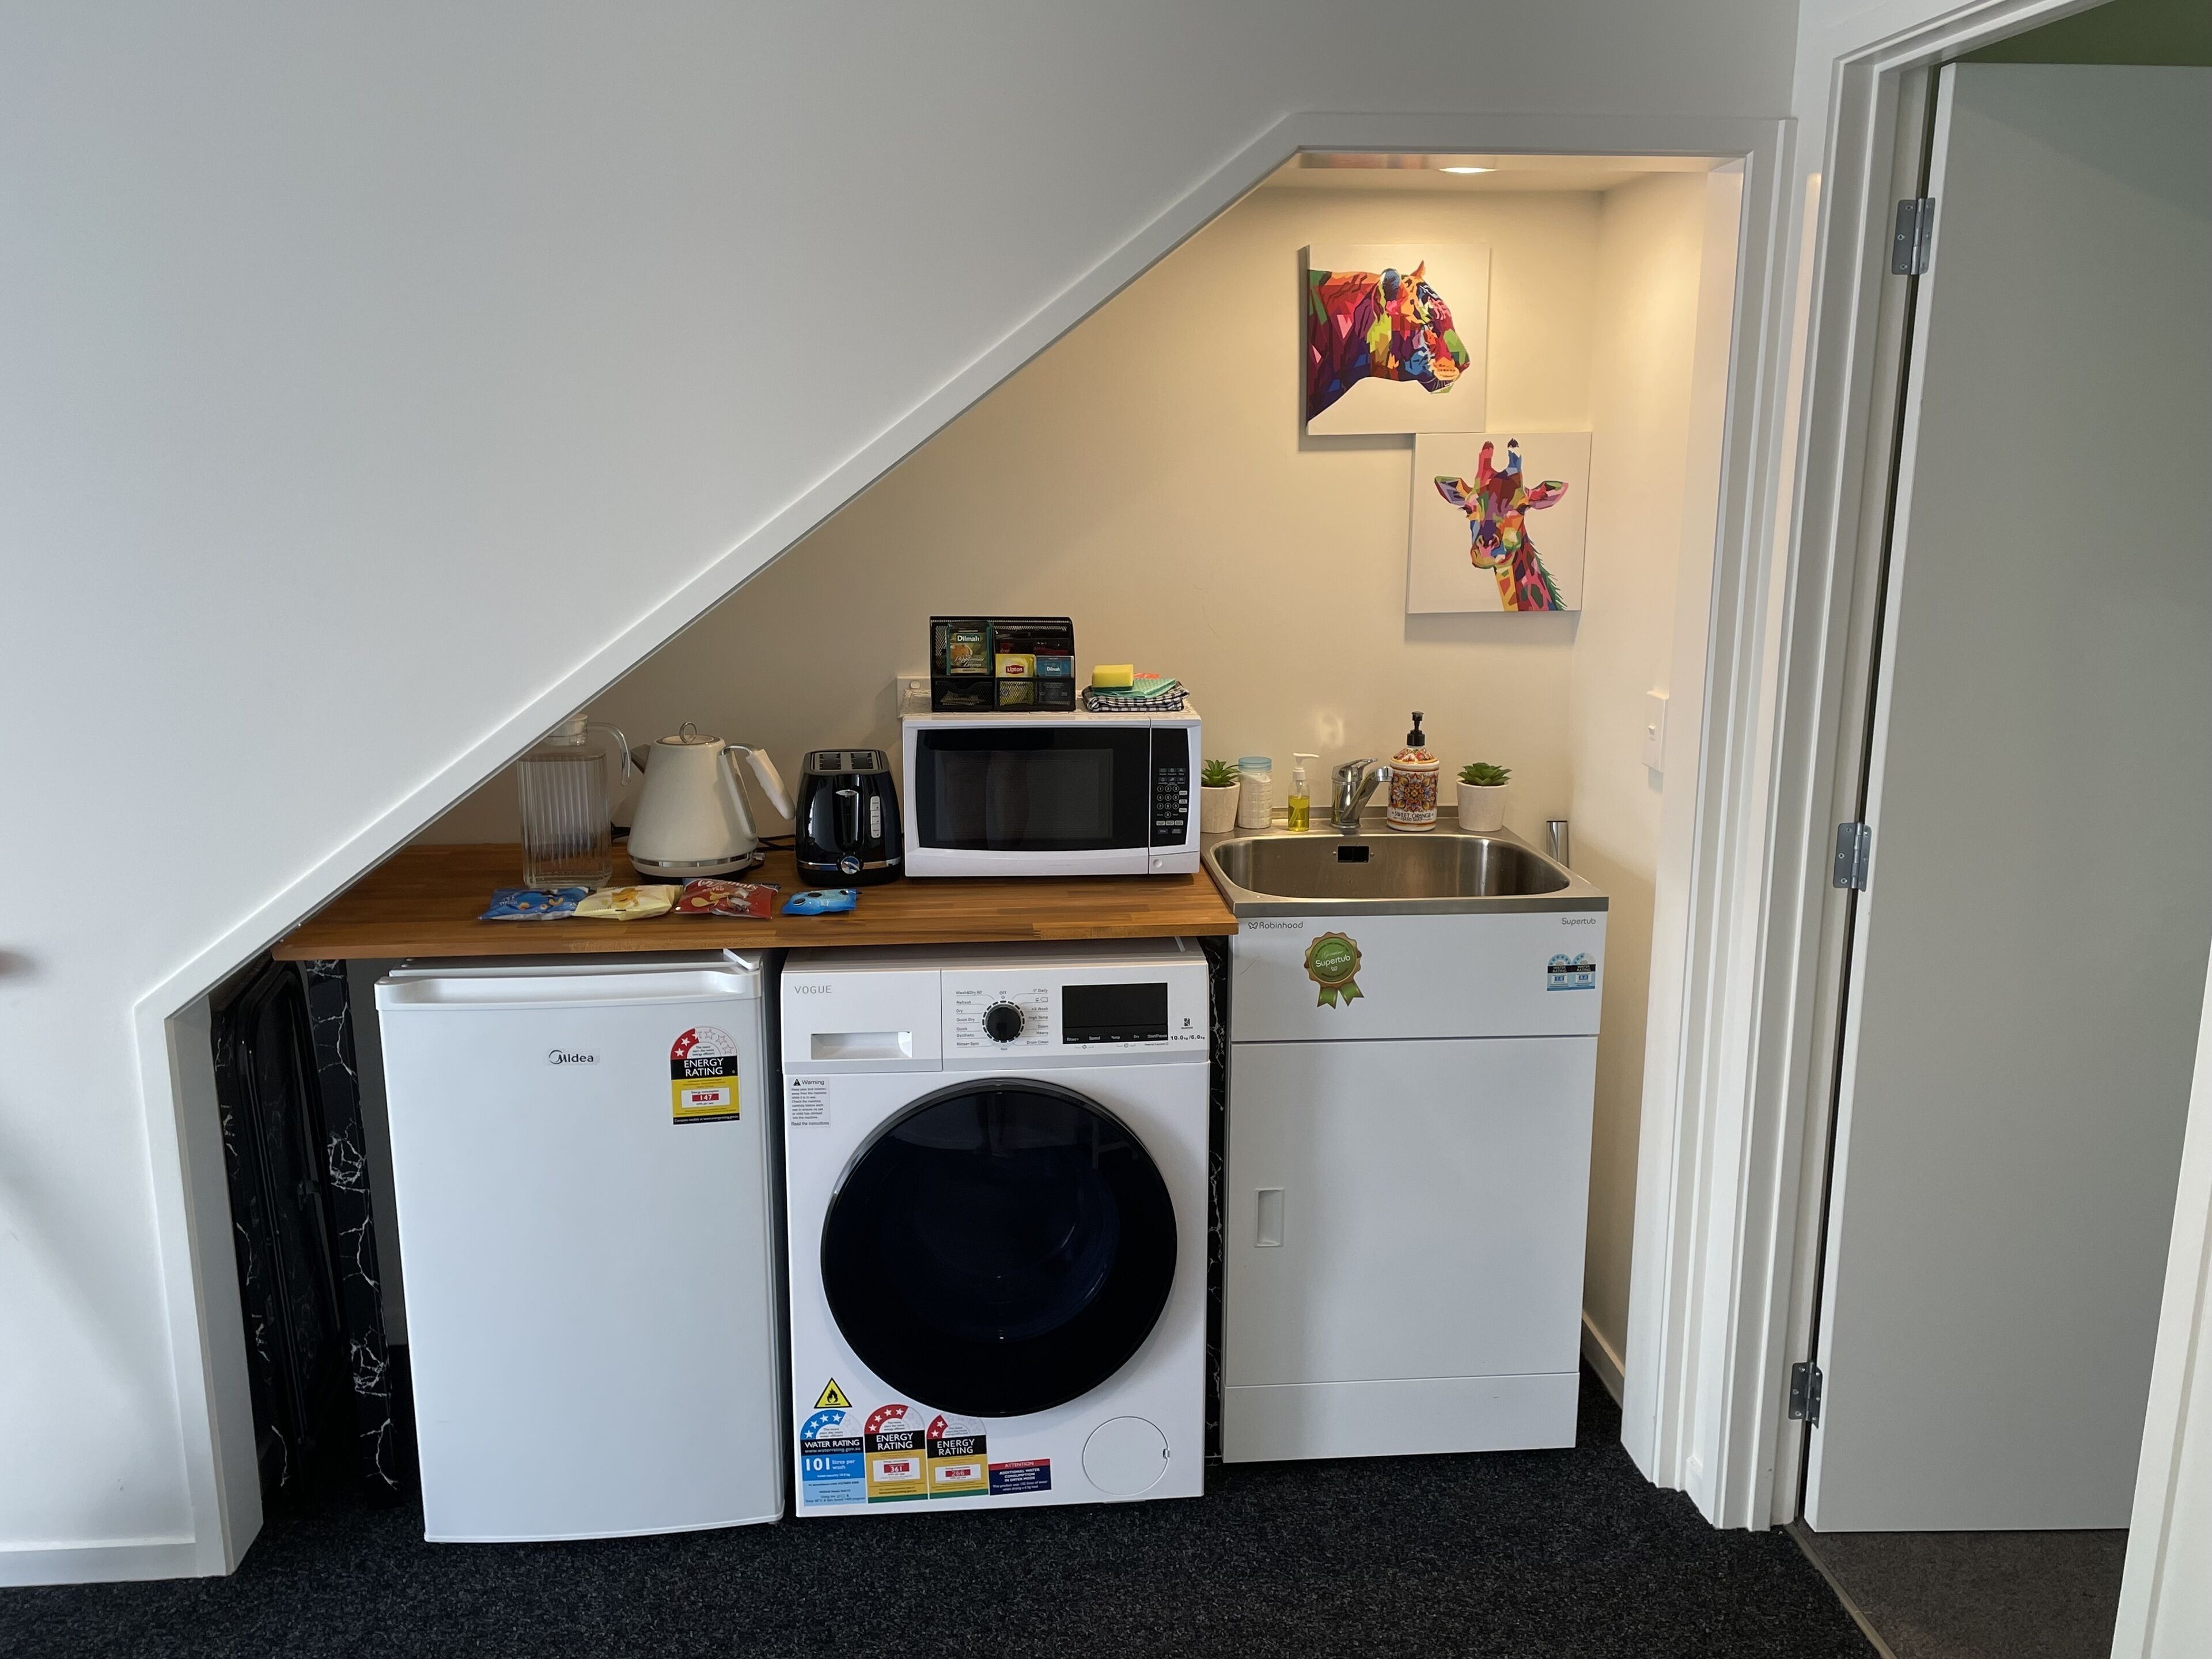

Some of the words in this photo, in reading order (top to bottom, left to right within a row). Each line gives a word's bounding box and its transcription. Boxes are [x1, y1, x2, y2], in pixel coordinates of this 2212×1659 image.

[1562, 917, 1596, 926] Supertub
[1315, 954, 1351, 967] Supertub
[794, 986, 832, 994] VOGUE
[550, 1050, 594, 1065] Midea
[684, 1058, 724, 1068] ENERGY
[685, 1067, 724, 1077] RATING
[876, 1433, 914, 1442] ENERGY
[877, 1441, 913, 1450] RATING
[937, 1438, 975, 1448] ENERGY
[938, 1446, 974, 1456] RATING
[806, 1457, 830, 1471] 101
